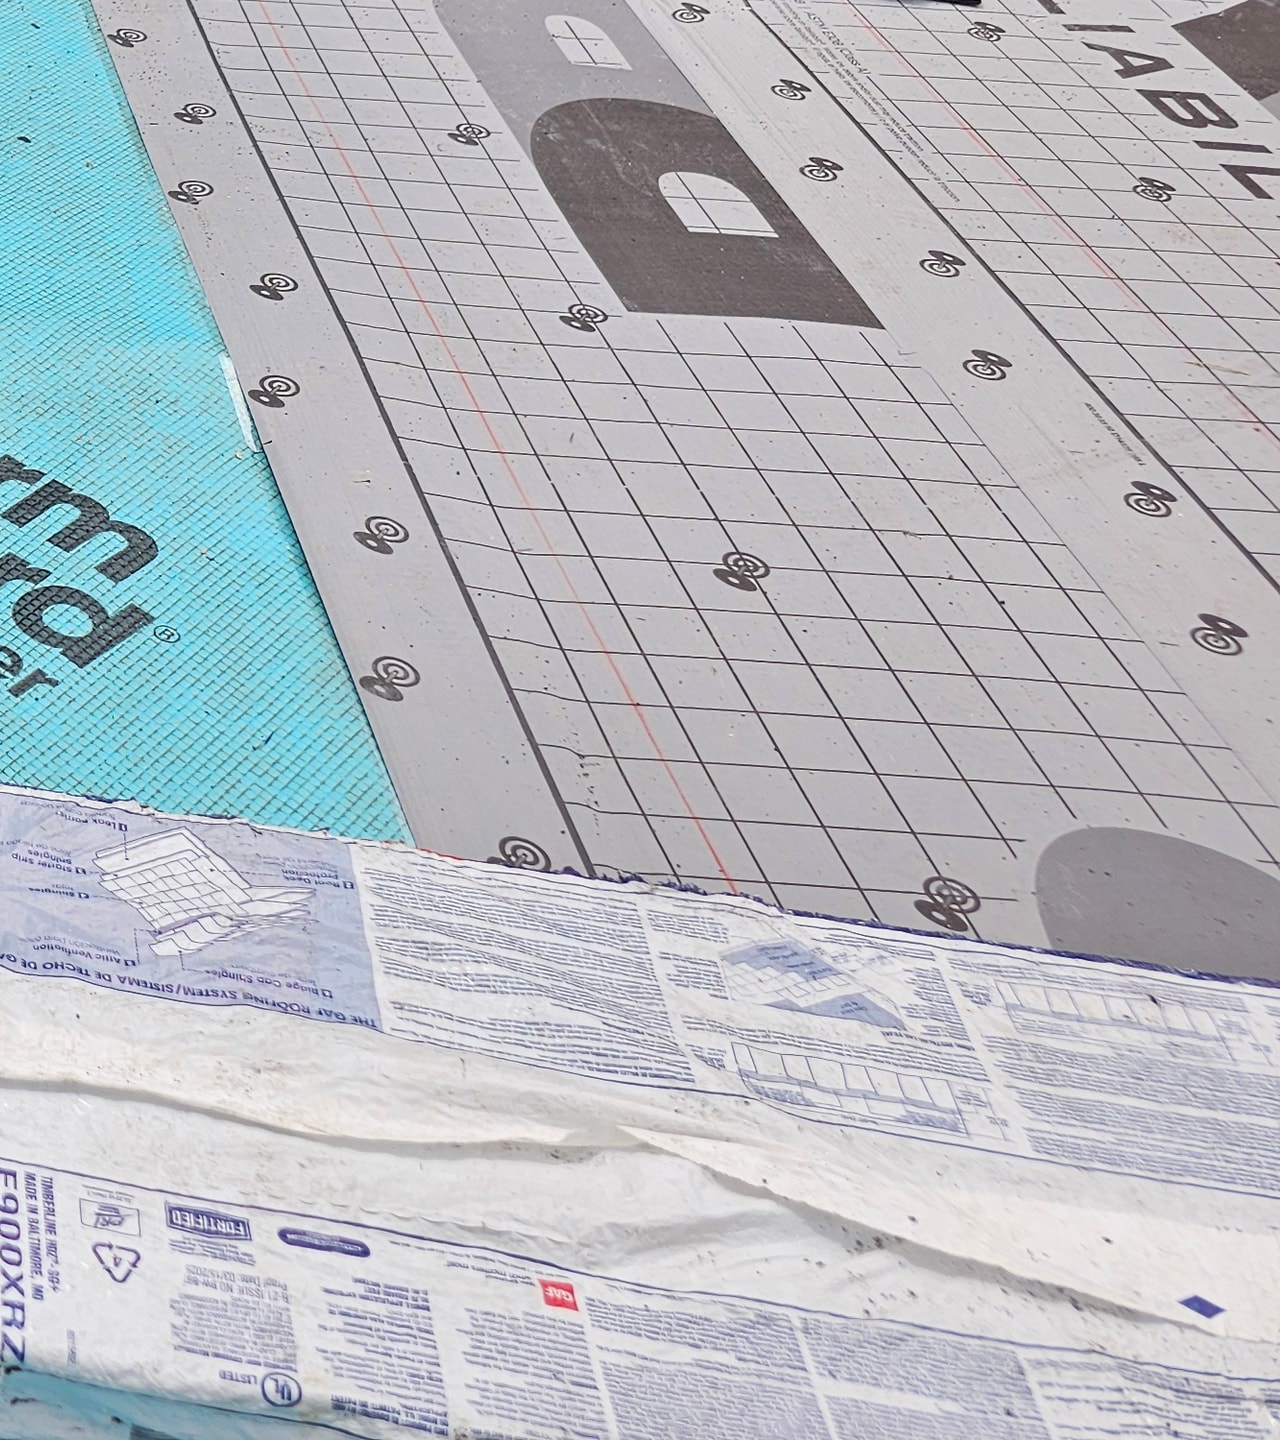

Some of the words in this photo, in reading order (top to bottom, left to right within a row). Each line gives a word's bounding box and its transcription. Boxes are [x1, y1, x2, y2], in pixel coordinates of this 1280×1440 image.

[91, 818, 115, 829] Leak
[11, 851, 33, 864] Strip
[36, 859, 71, 871] Starter
[28, 887, 74, 897] Shingles
[20, 958, 36, 969] DE
[94, 952, 120, 964] Attic
[42, 961, 89, 975] TECHO
[94, 970, 111, 981] DE
[255, 974, 280, 987] Cap
[350, 1014, 375, 1028] THE
[23, 1171, 34, 1200] MADE
[39, 1175, 56, 1234] TIMBERLINE
[172, 1209, 243, 1234] FORTIFIED
[27, 1217, 39, 1277] BALTIMORE,
[236, 1285, 264, 1298] ISSUE
[544, 1285, 572, 1300] GAF
[218, 1369, 257, 1384] LISTED
[330, 1394, 356, 1405] PATENT
